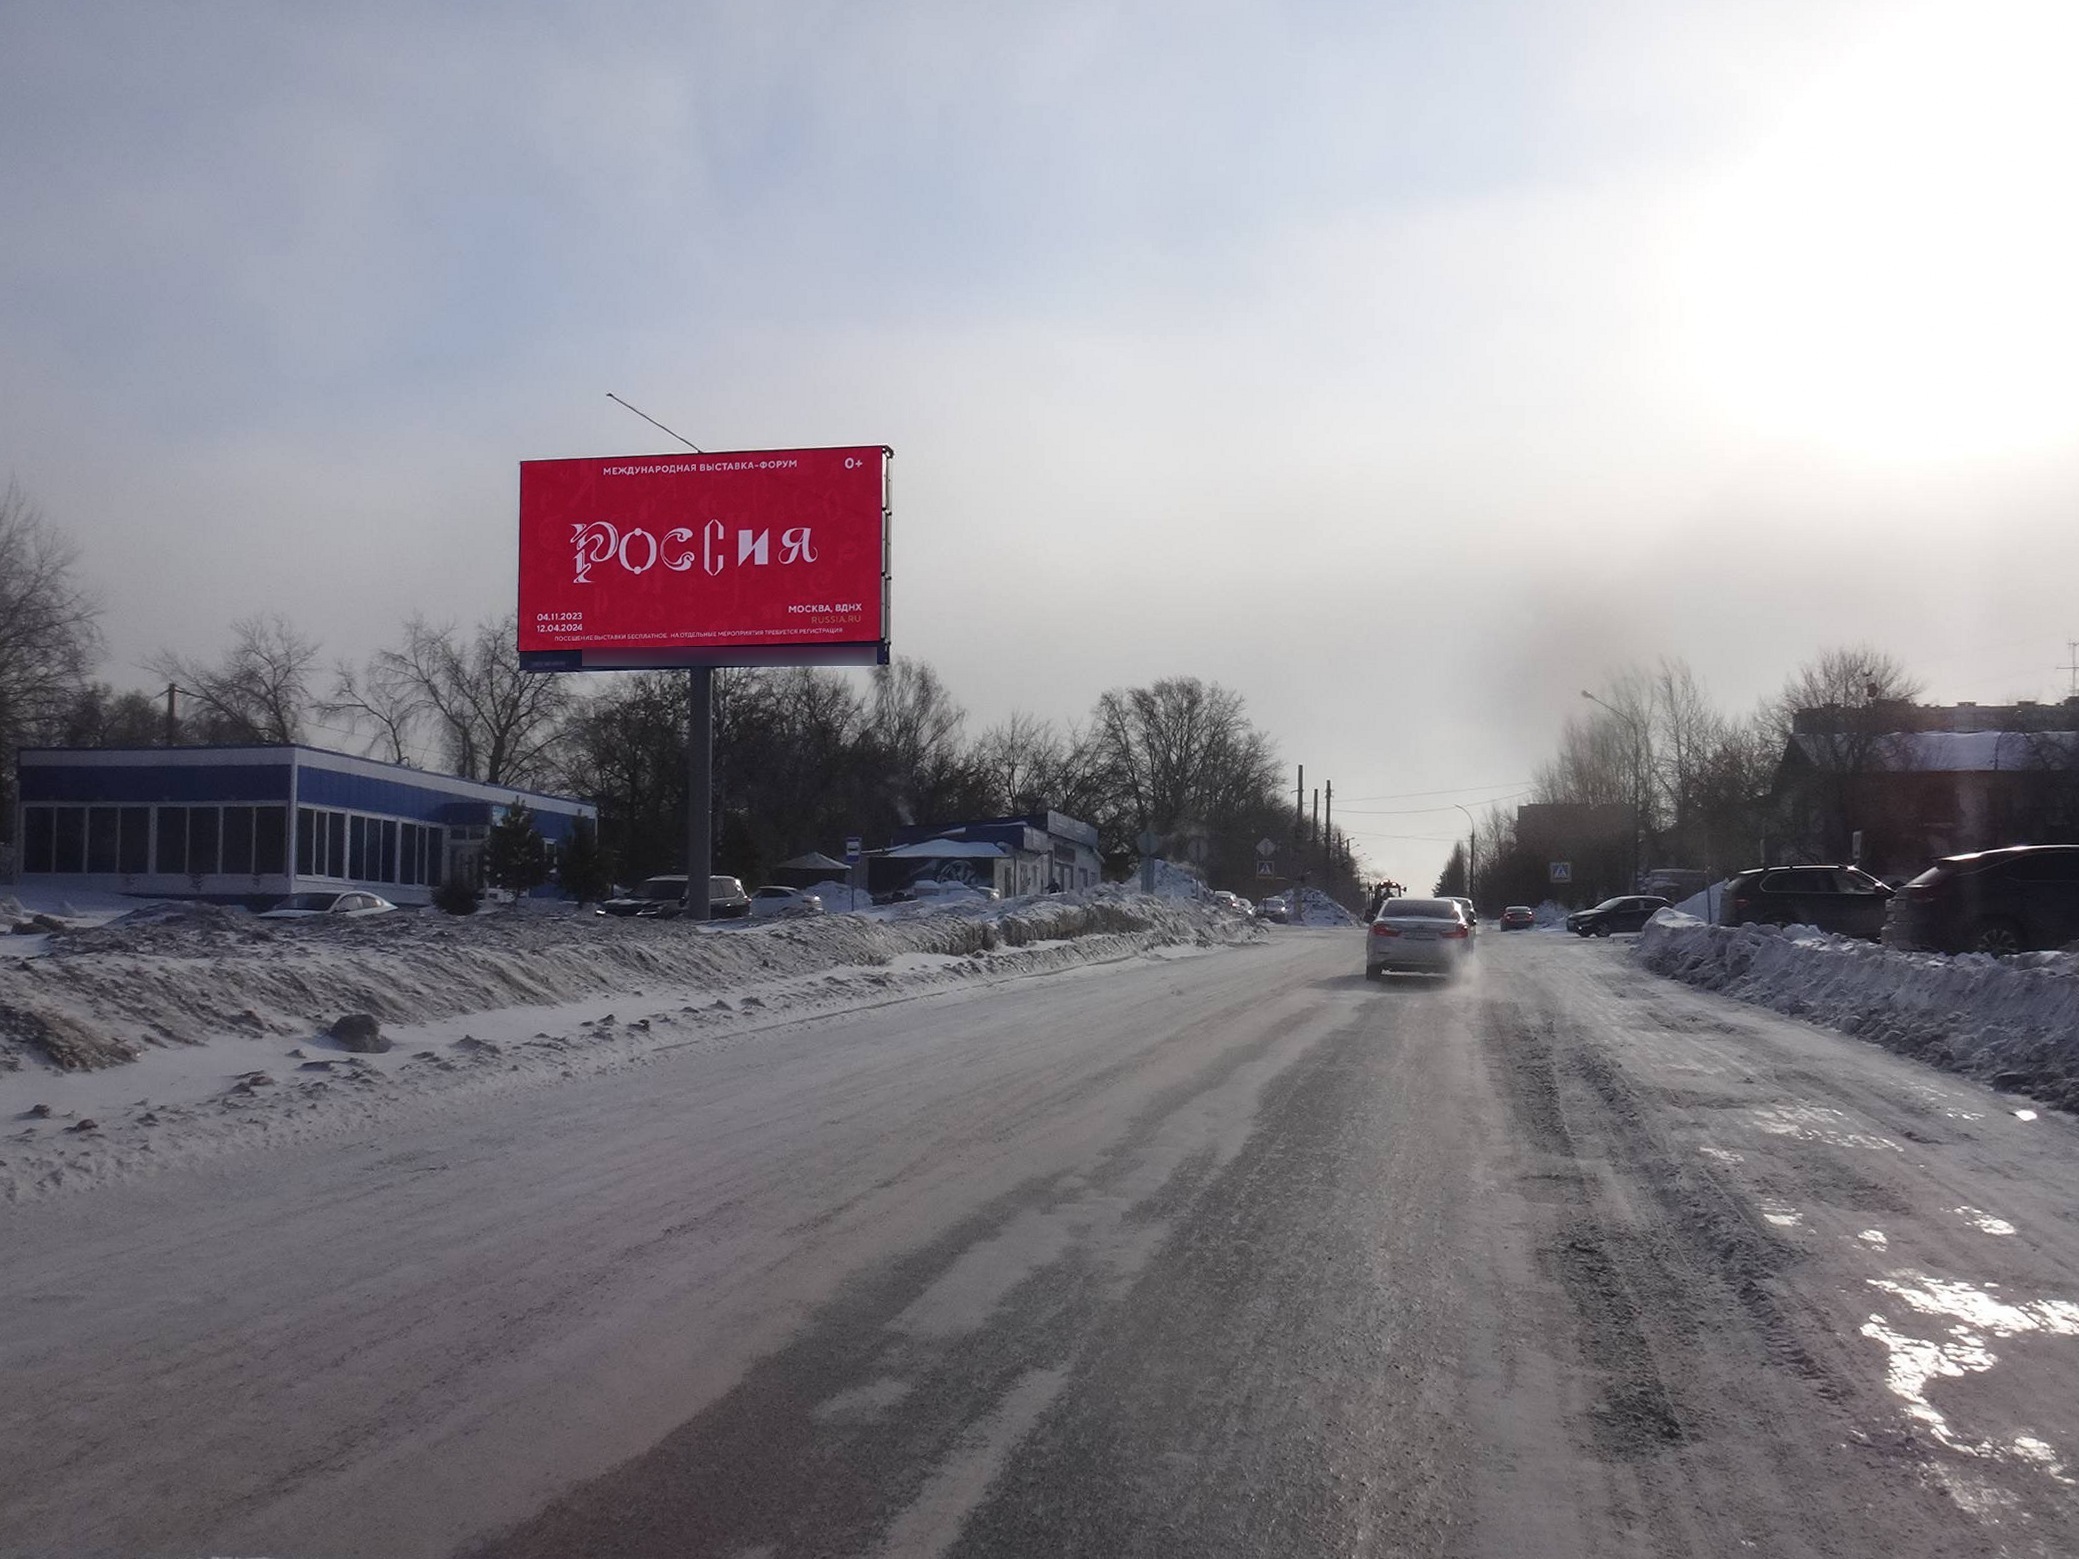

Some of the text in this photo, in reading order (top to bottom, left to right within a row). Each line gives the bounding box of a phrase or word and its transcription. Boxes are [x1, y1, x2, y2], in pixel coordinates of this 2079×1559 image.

[603, 460, 798, 476] МЕЖДУНАРОДНАЯ ВЫСТАВКА-ФОРУМ
[844, 457, 863, 469] 0+
[570, 519, 819, 583] РОССИЯ
[788, 603, 862, 613] МОСКВА, ВДНХ
[536, 612, 583, 621] 04.11.2023
[811, 615, 862, 624] RUSSIA.RU
[536, 623, 583, 633] 12.04.2024
